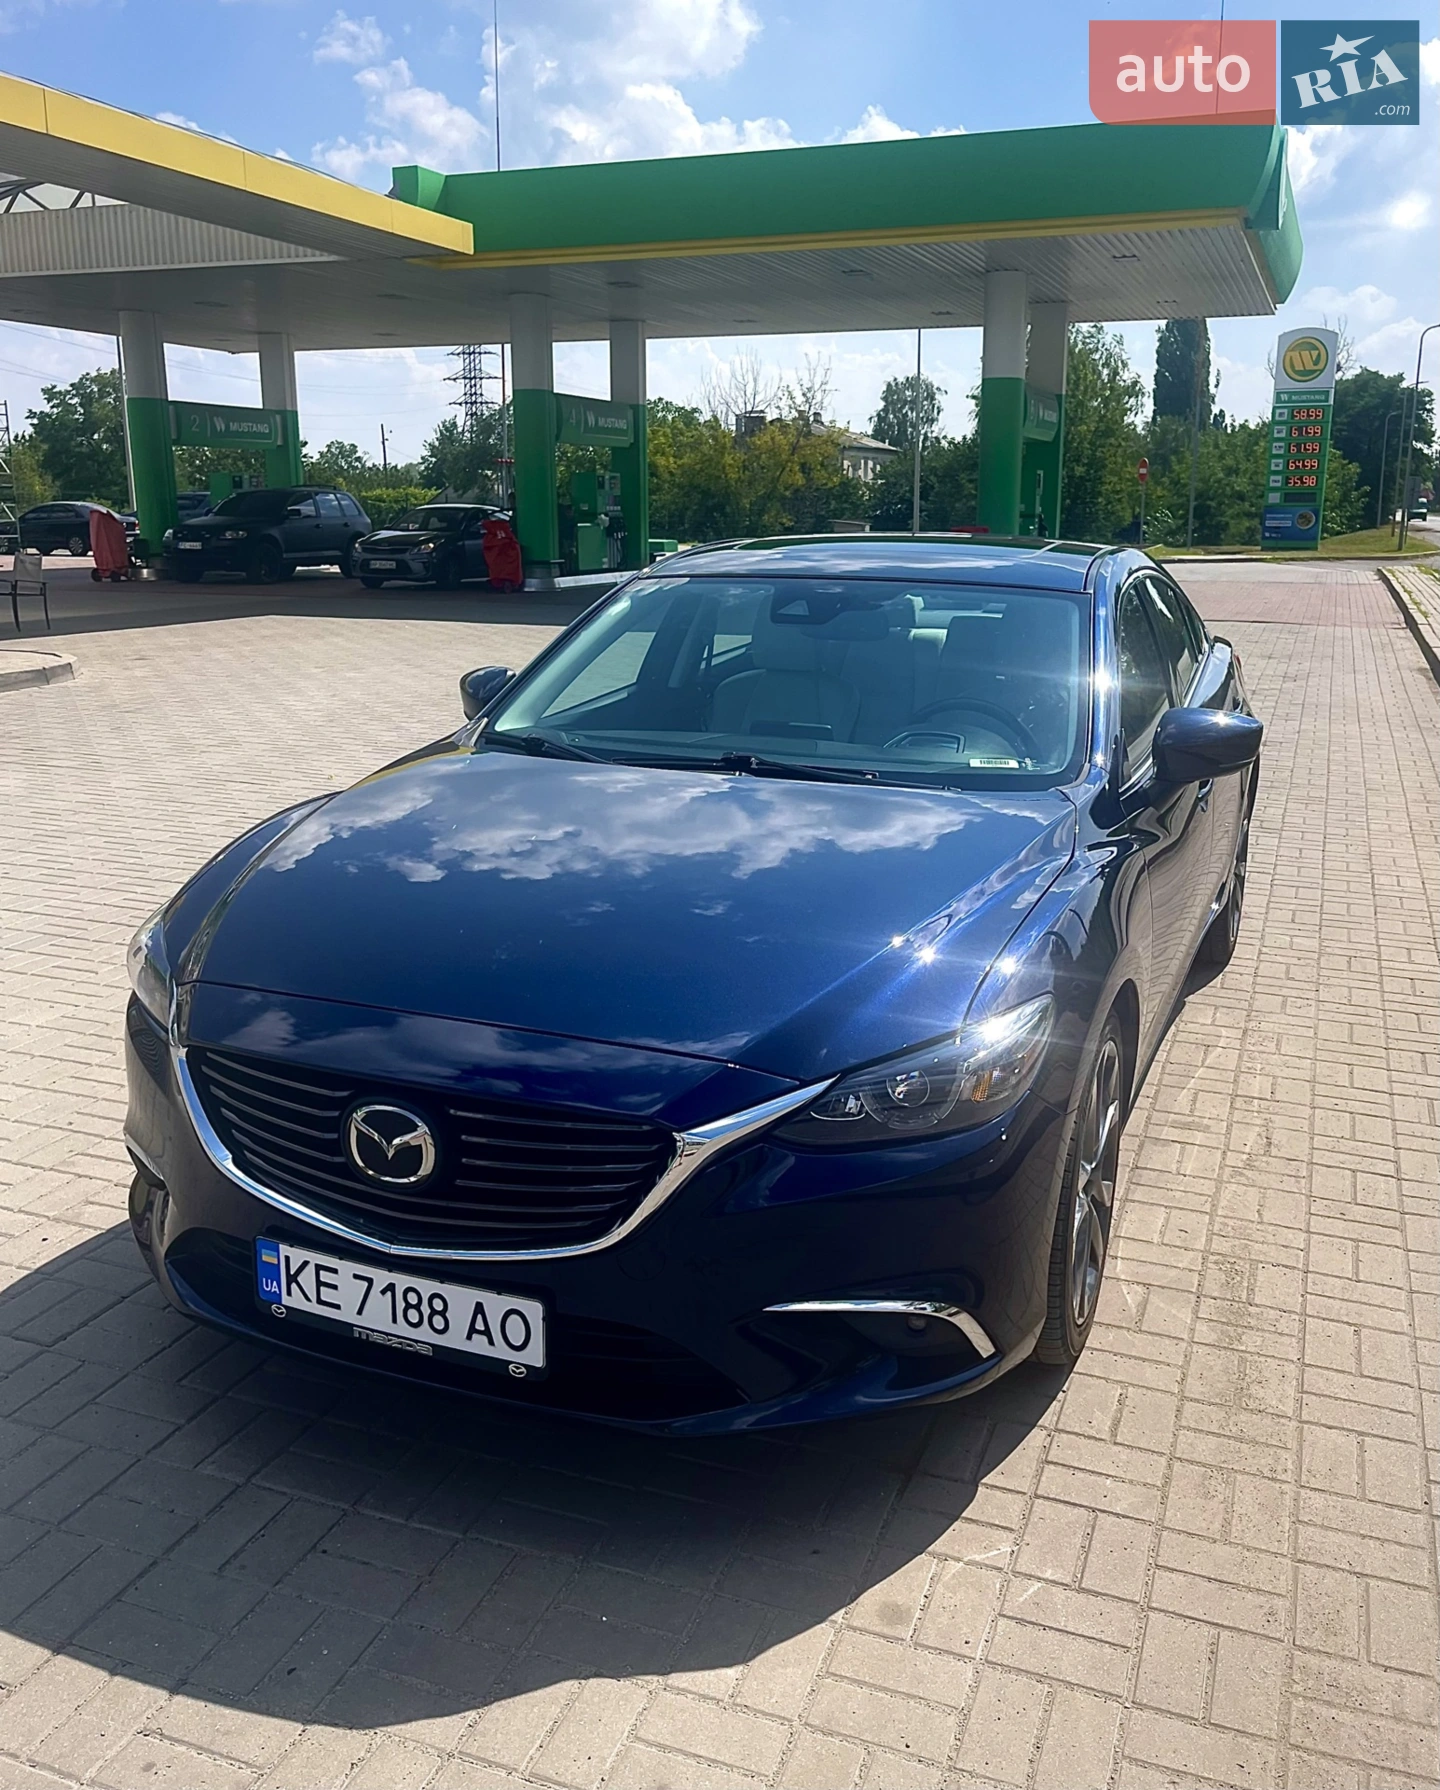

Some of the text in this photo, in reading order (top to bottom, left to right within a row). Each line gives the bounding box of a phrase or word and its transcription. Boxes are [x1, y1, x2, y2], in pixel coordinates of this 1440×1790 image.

[569, 407, 576, 426] 4
[598, 417, 627, 430] MUSTANG
[1293, 409, 1323, 420] 58.99
[190, 414, 200, 432] 2
[229, 421, 270, 433] MUSTANG
[1291, 425, 1321, 437] 61.99
[1290, 442, 1320, 454] 61.99
[1288, 459, 1318, 470] 64.99
[1288, 475, 1316, 487] 35.98
[263, 1277, 280, 1294] UA
[284, 1255, 532, 1352] KE 7188 AO
